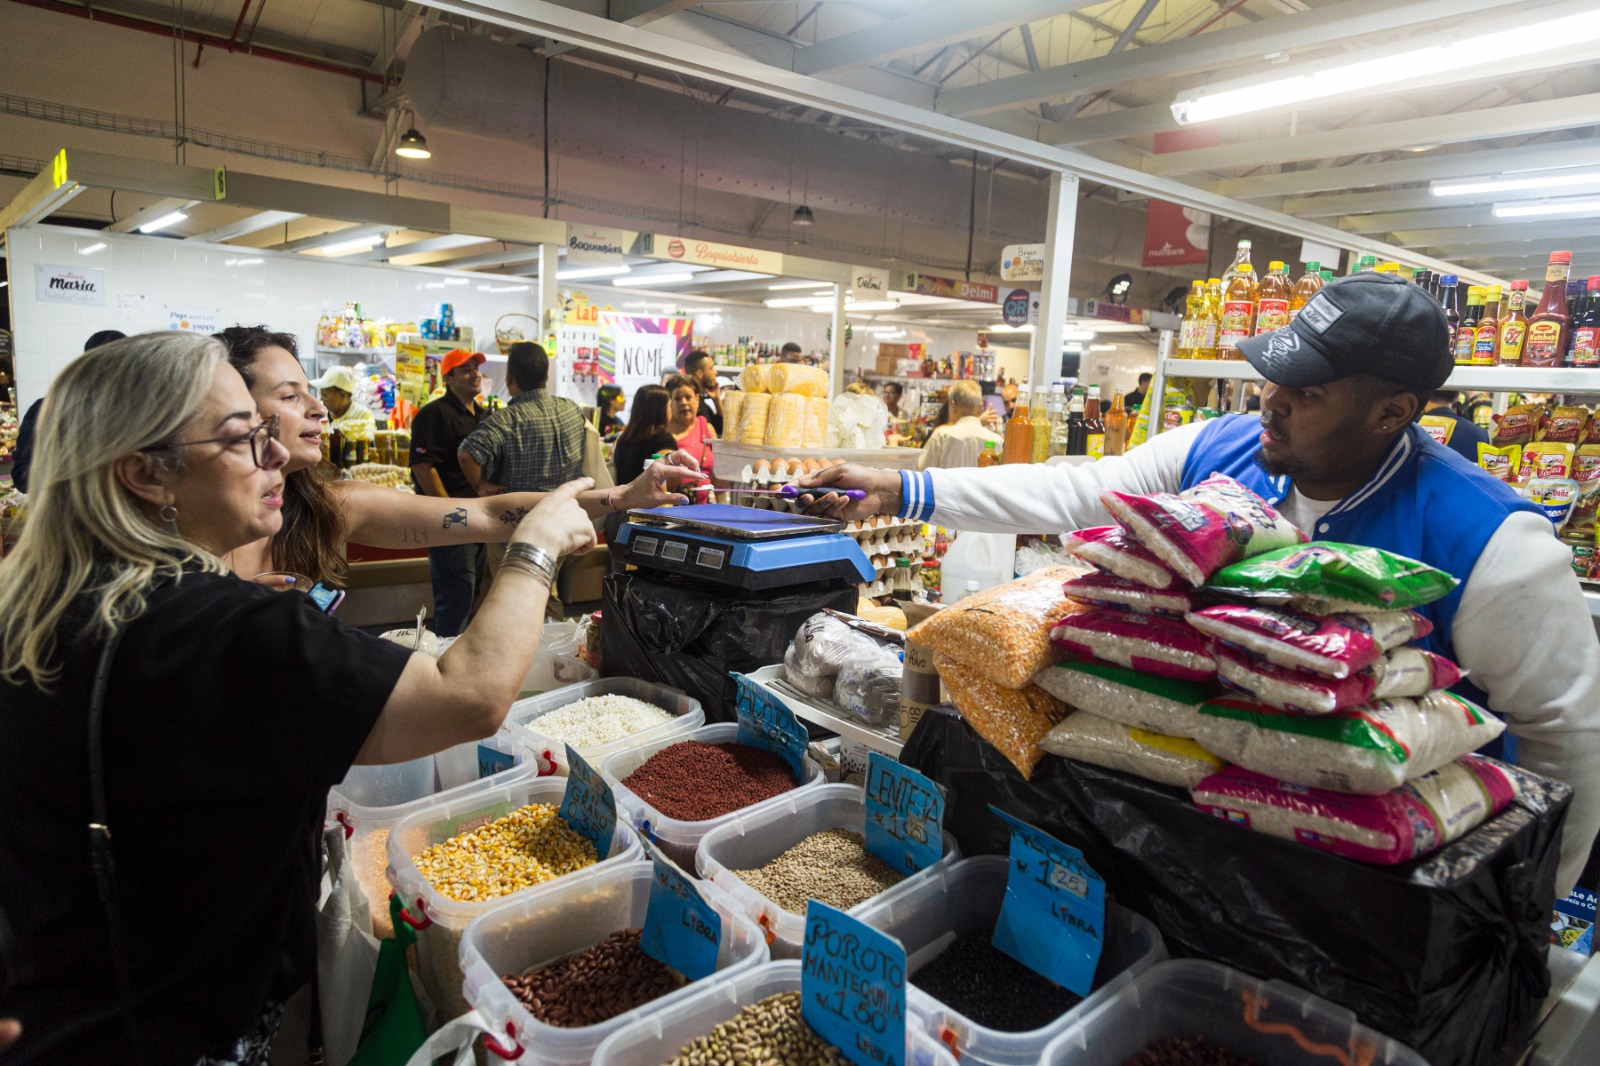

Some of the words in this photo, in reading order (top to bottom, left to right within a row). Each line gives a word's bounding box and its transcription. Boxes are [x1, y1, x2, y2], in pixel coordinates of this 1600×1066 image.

[695, 242, 759, 265] Boquiabierta
[960, 283, 994, 301] Delmi
[576, 304, 589, 321] La
[1004, 300, 1028, 316] QR
[192, 322, 216, 332] yappy
[1008, 315, 1027, 324] Nequi
[1503, 328, 1523, 343] 57
[1552, 489, 1570, 498] Doña
[682, 908, 718, 946] LIBRA
[1052, 901, 1098, 939] LIBRA
[806, 915, 904, 989] POROTO
